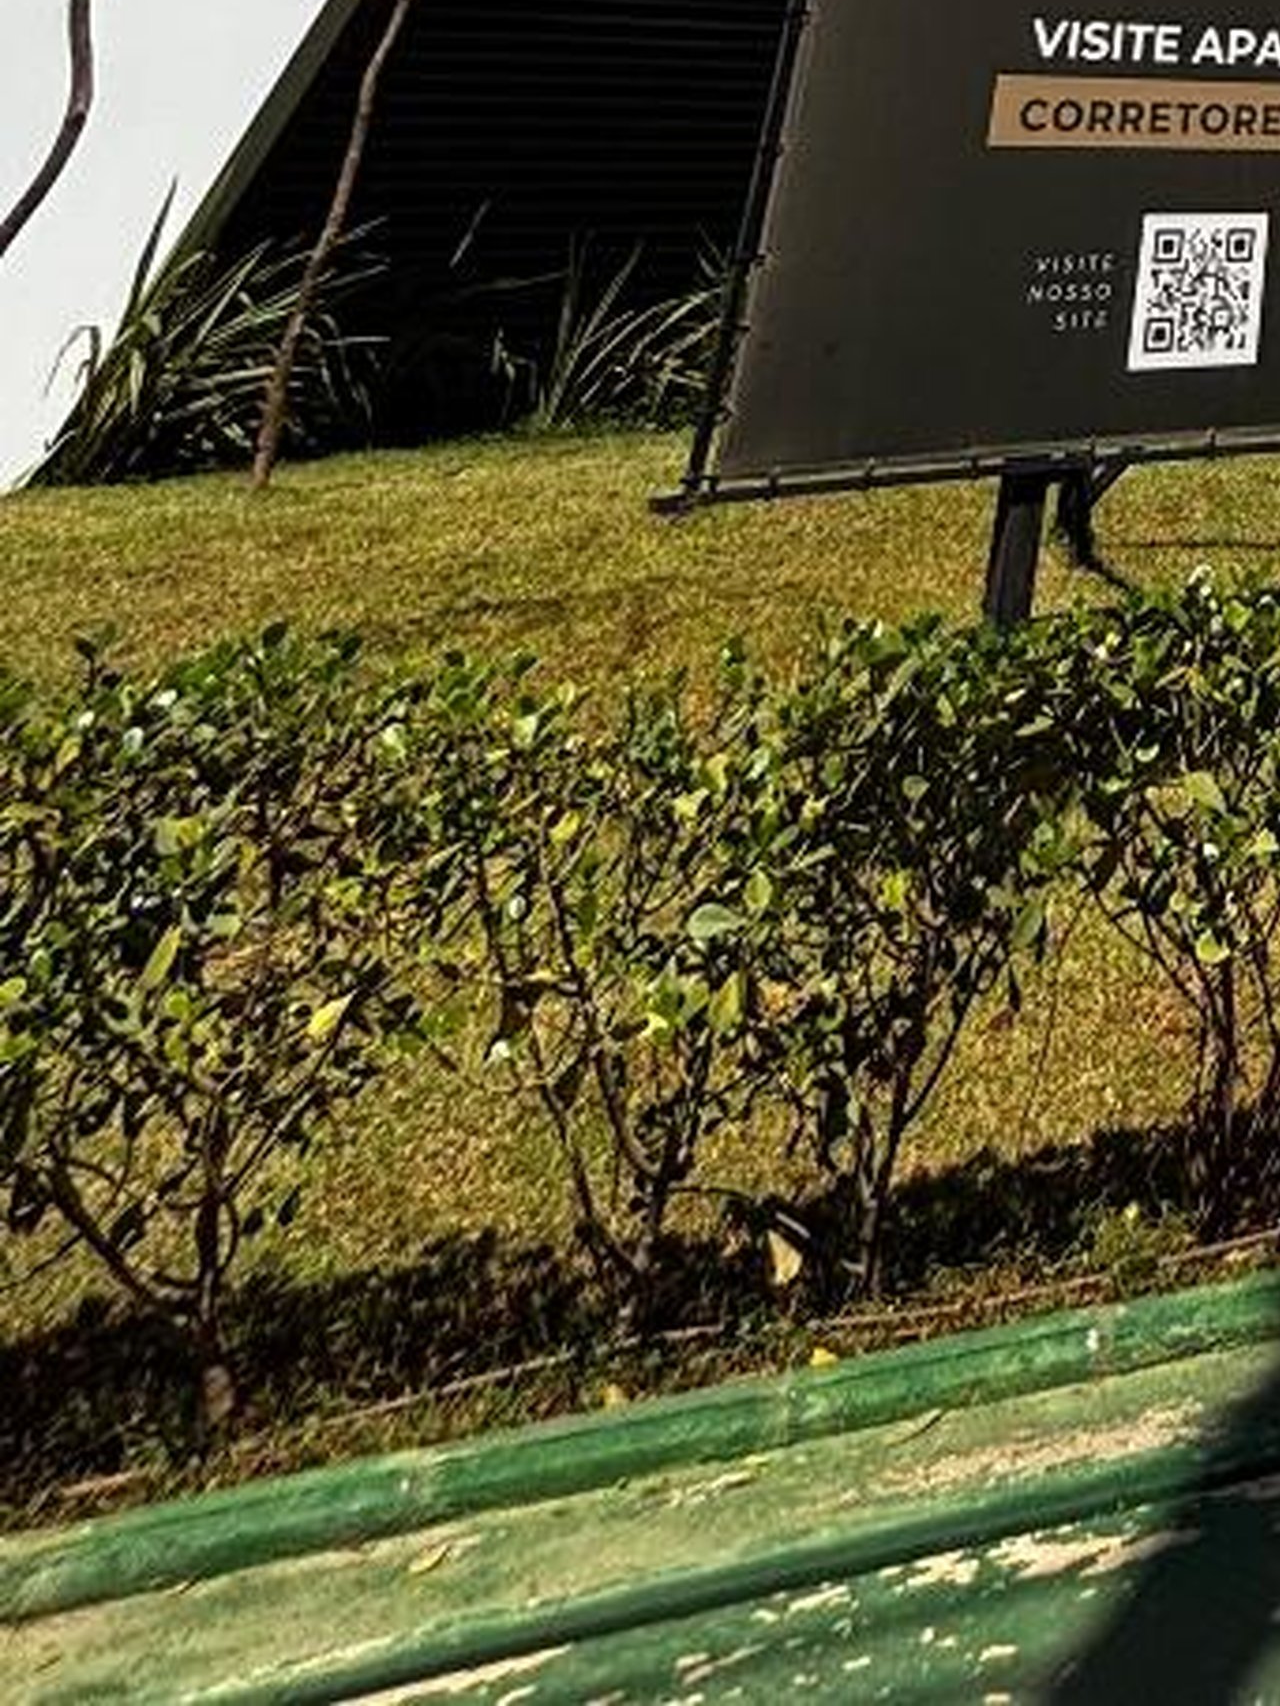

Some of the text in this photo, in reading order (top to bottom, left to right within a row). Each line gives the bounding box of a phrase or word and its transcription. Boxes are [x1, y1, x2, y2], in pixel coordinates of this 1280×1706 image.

[1033, 18, 1182, 63] VISITE
[1035, 254, 1114, 274] VISITE
[1028, 284, 1112, 303] NOSSO
[1054, 310, 1107, 331] SITE
